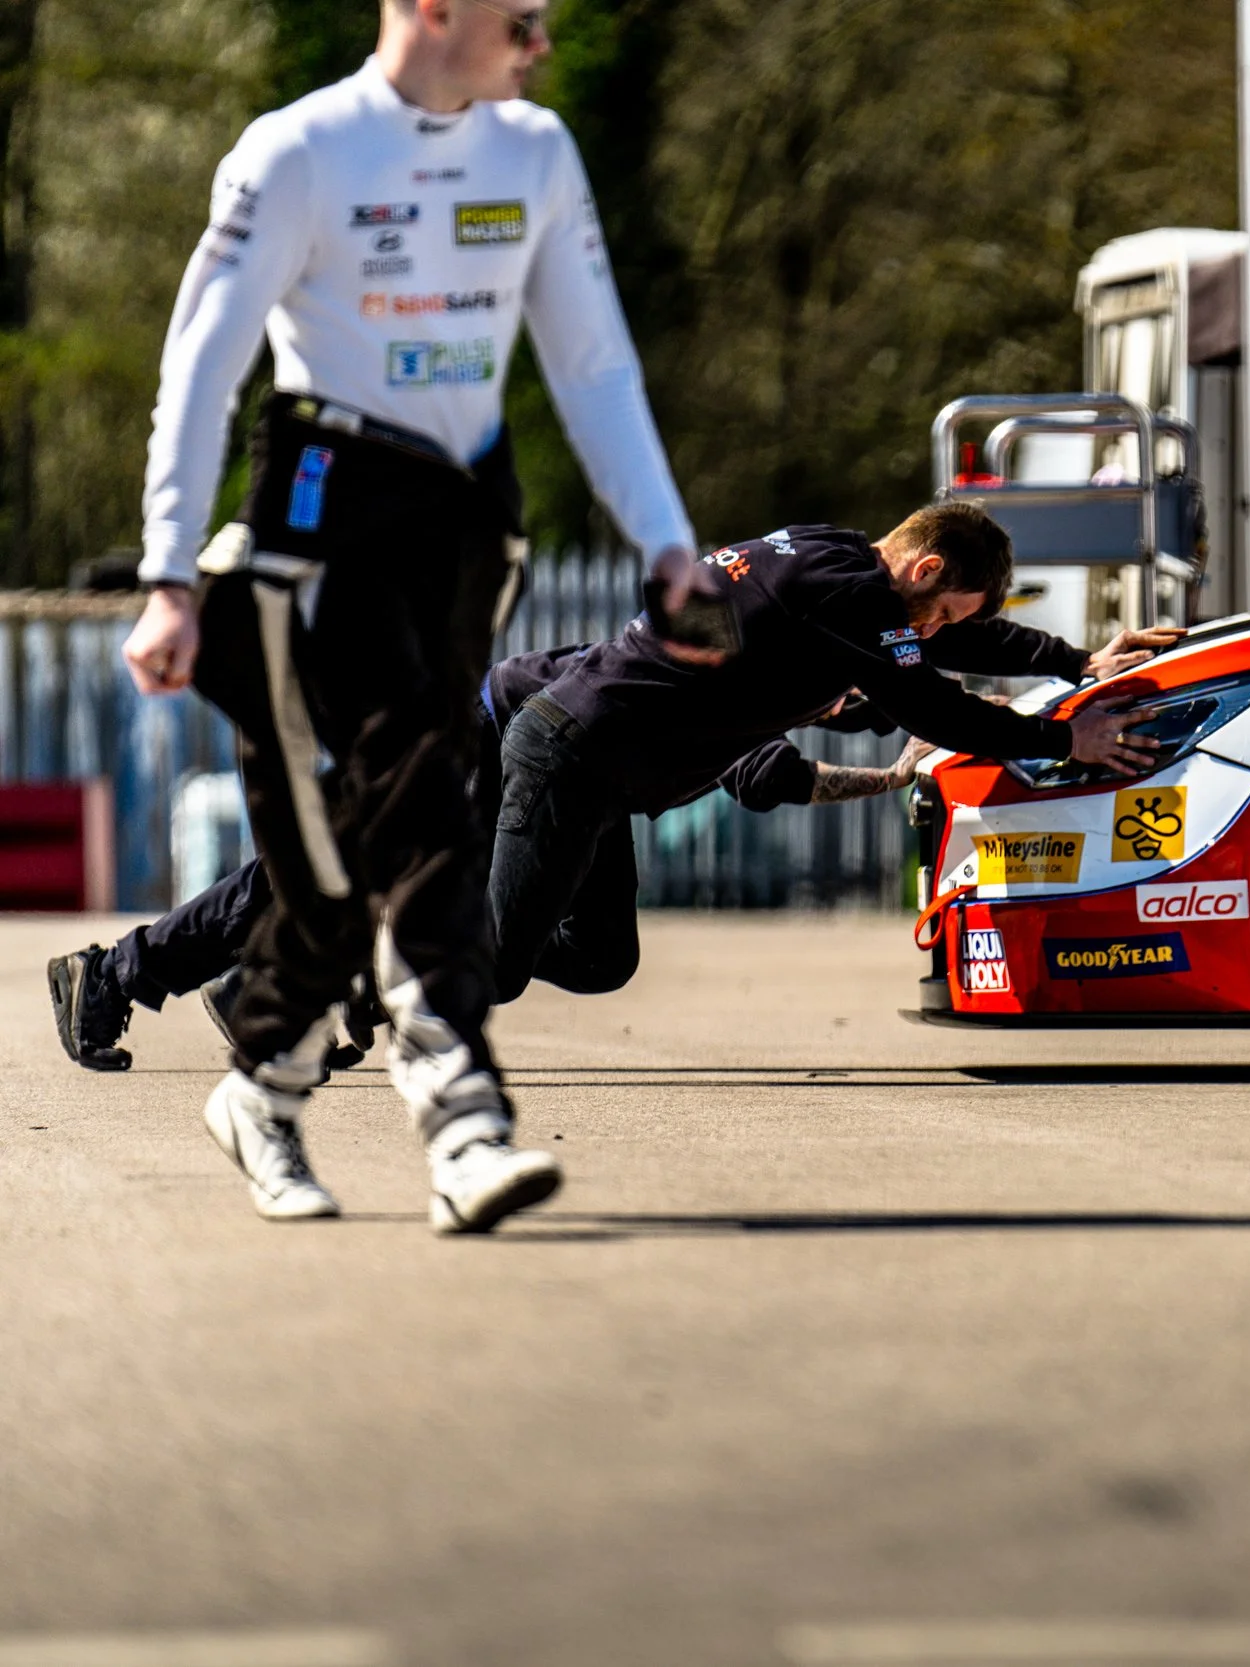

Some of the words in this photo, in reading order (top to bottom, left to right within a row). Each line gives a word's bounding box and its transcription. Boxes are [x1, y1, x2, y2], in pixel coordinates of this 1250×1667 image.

[983, 834, 1076, 862] Mikeysline
[1142, 885, 1238, 918] aalco
[963, 932, 1003, 960] LIQUI
[963, 961, 1006, 990] MOLY
